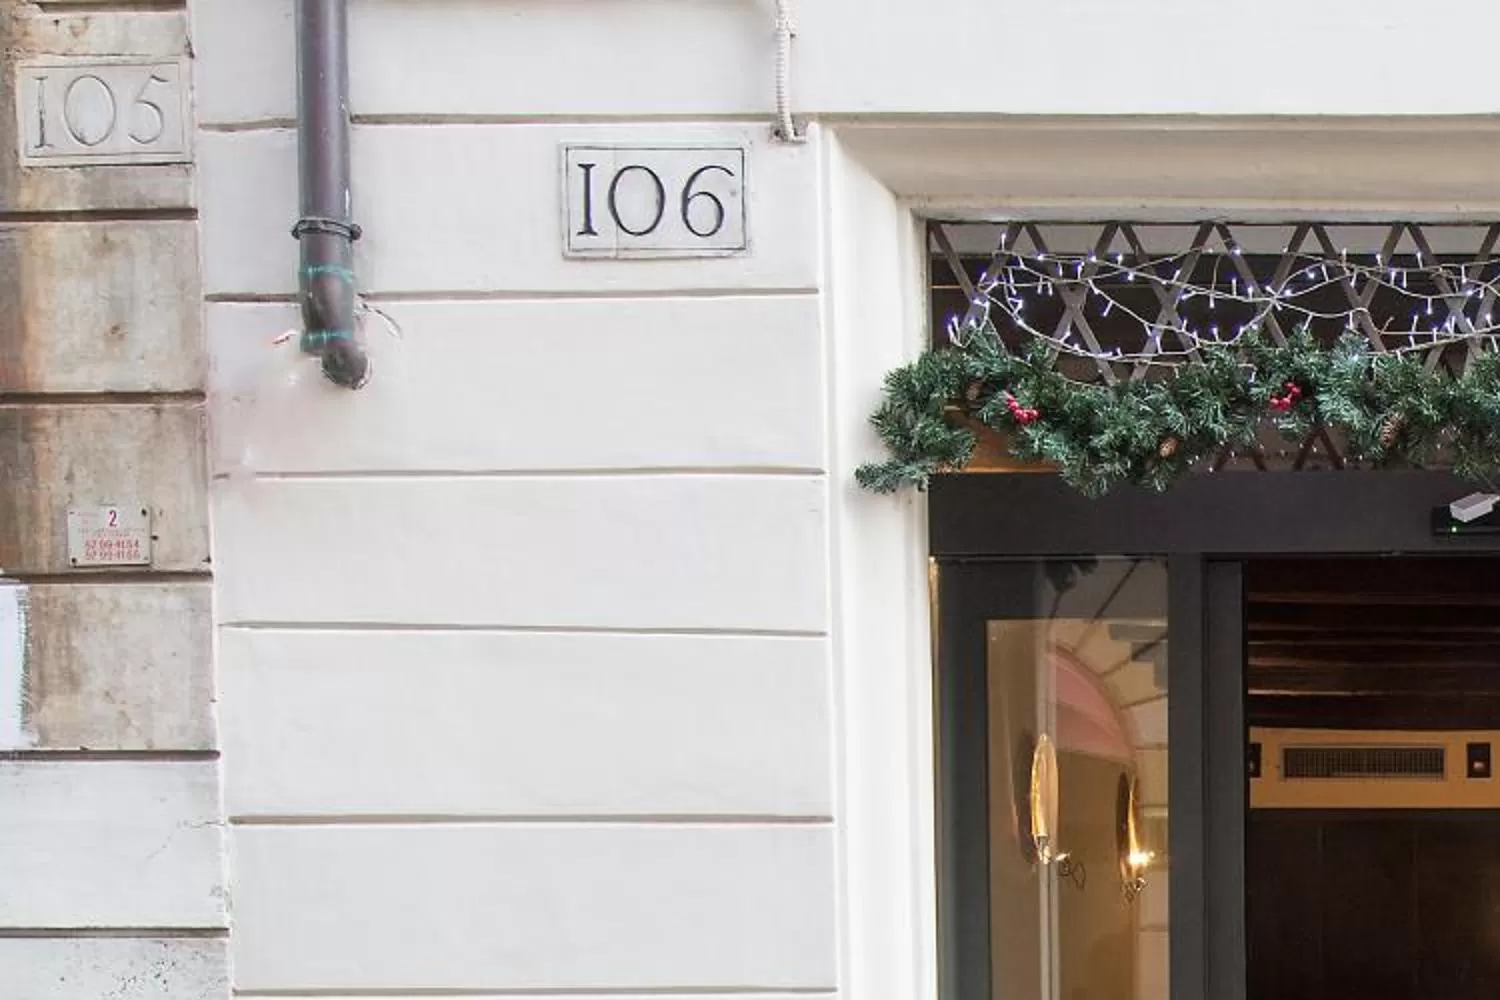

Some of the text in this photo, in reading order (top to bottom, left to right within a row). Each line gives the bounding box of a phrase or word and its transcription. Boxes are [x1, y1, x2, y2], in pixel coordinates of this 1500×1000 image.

[33, 74, 170, 148] 105
[577, 163, 735, 237] 106
[109, 509, 118, 528] 2
